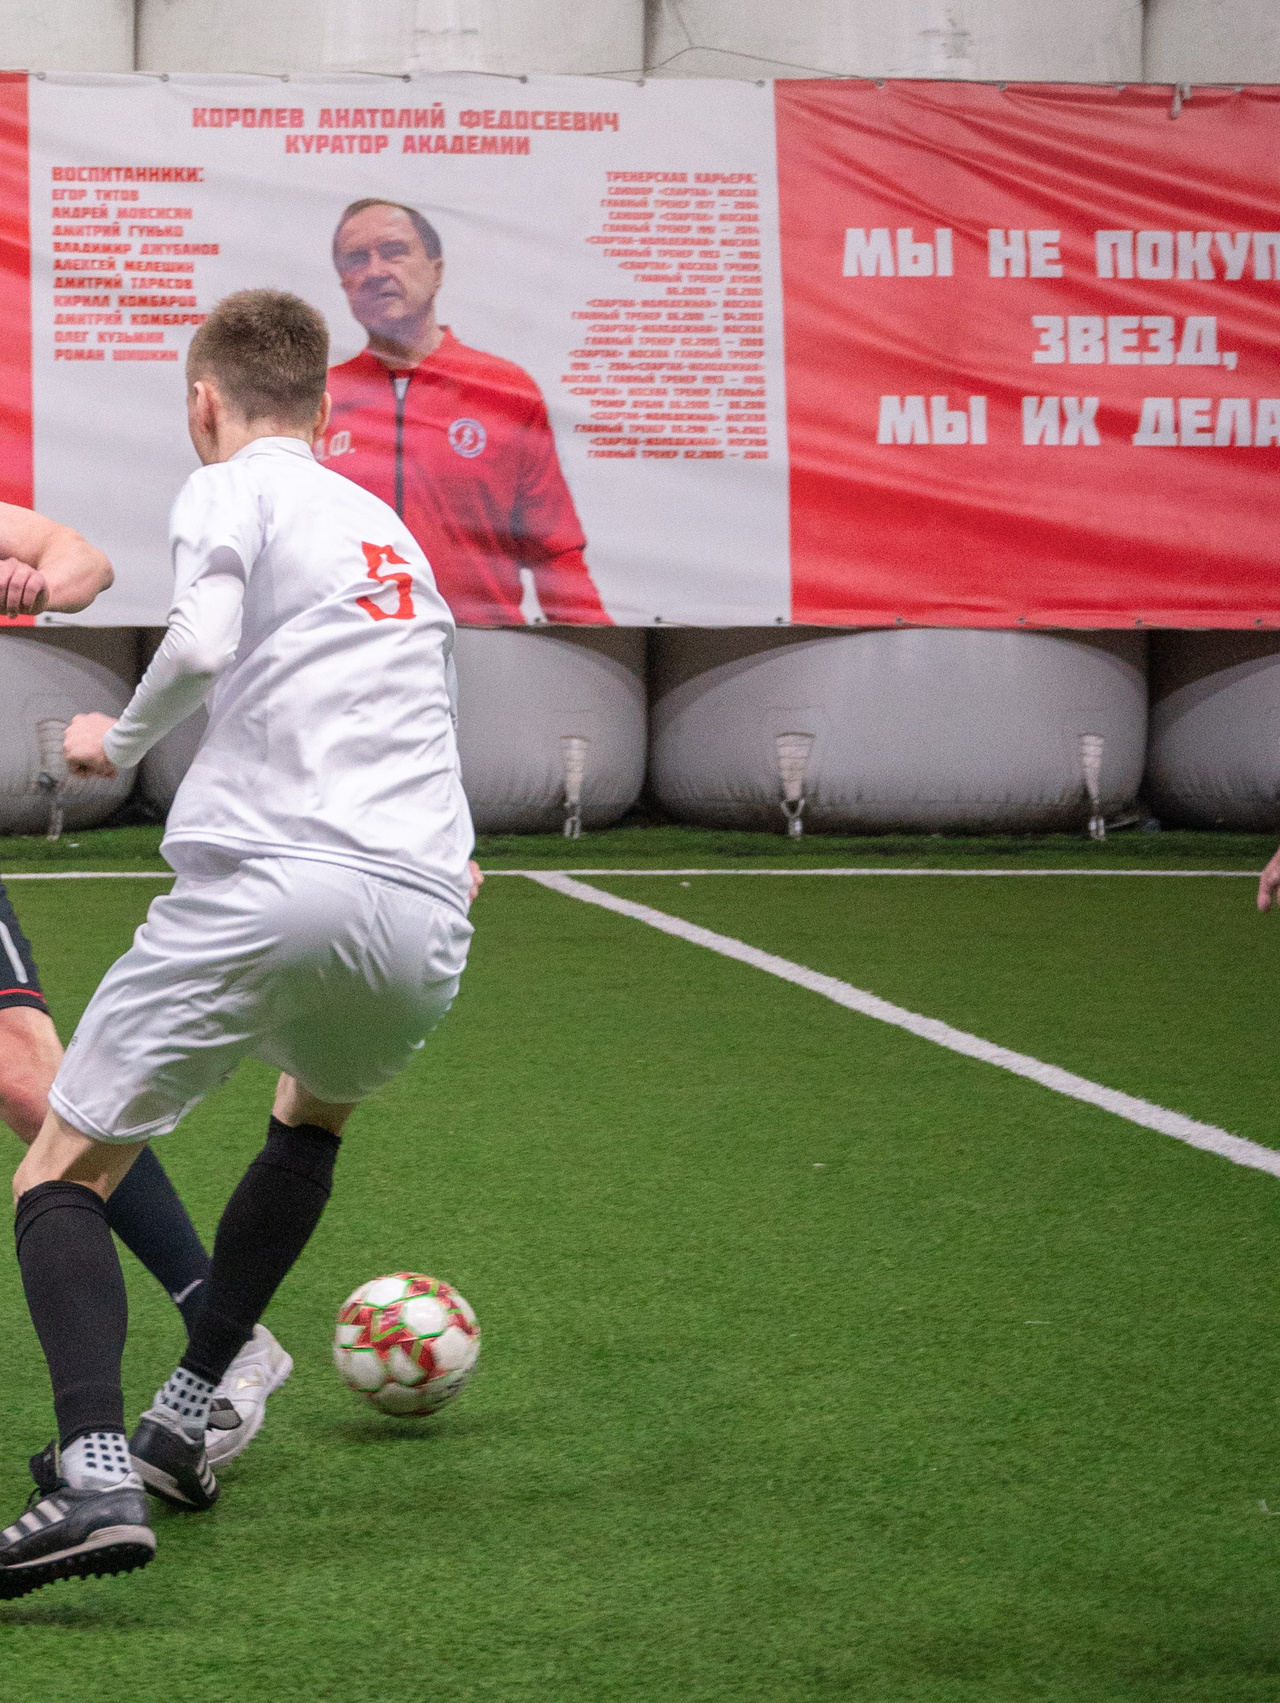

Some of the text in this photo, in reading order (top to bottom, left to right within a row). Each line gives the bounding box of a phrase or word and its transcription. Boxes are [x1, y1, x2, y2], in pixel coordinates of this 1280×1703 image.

[193, 102, 620, 131] КОРОЛЕВ АНАТОЛИЙ ФЕДОСЕЕВИЧ
[285, 134, 531, 156] КУРАТОР АКАДЕМИИ
[51, 166, 204, 183] ВОСПИТАННИКИ:
[51, 188, 139, 202] ЕГОР ТИТОВ
[842, 227, 953, 277] МЫ
[988, 229, 1063, 278] НЕ
[1032, 315, 1237, 370] ЗВЕЗД,
[877, 395, 988, 445] МЫ
[1023, 396, 1100, 446] ИХ
[356, 541, 417, 621] 5
